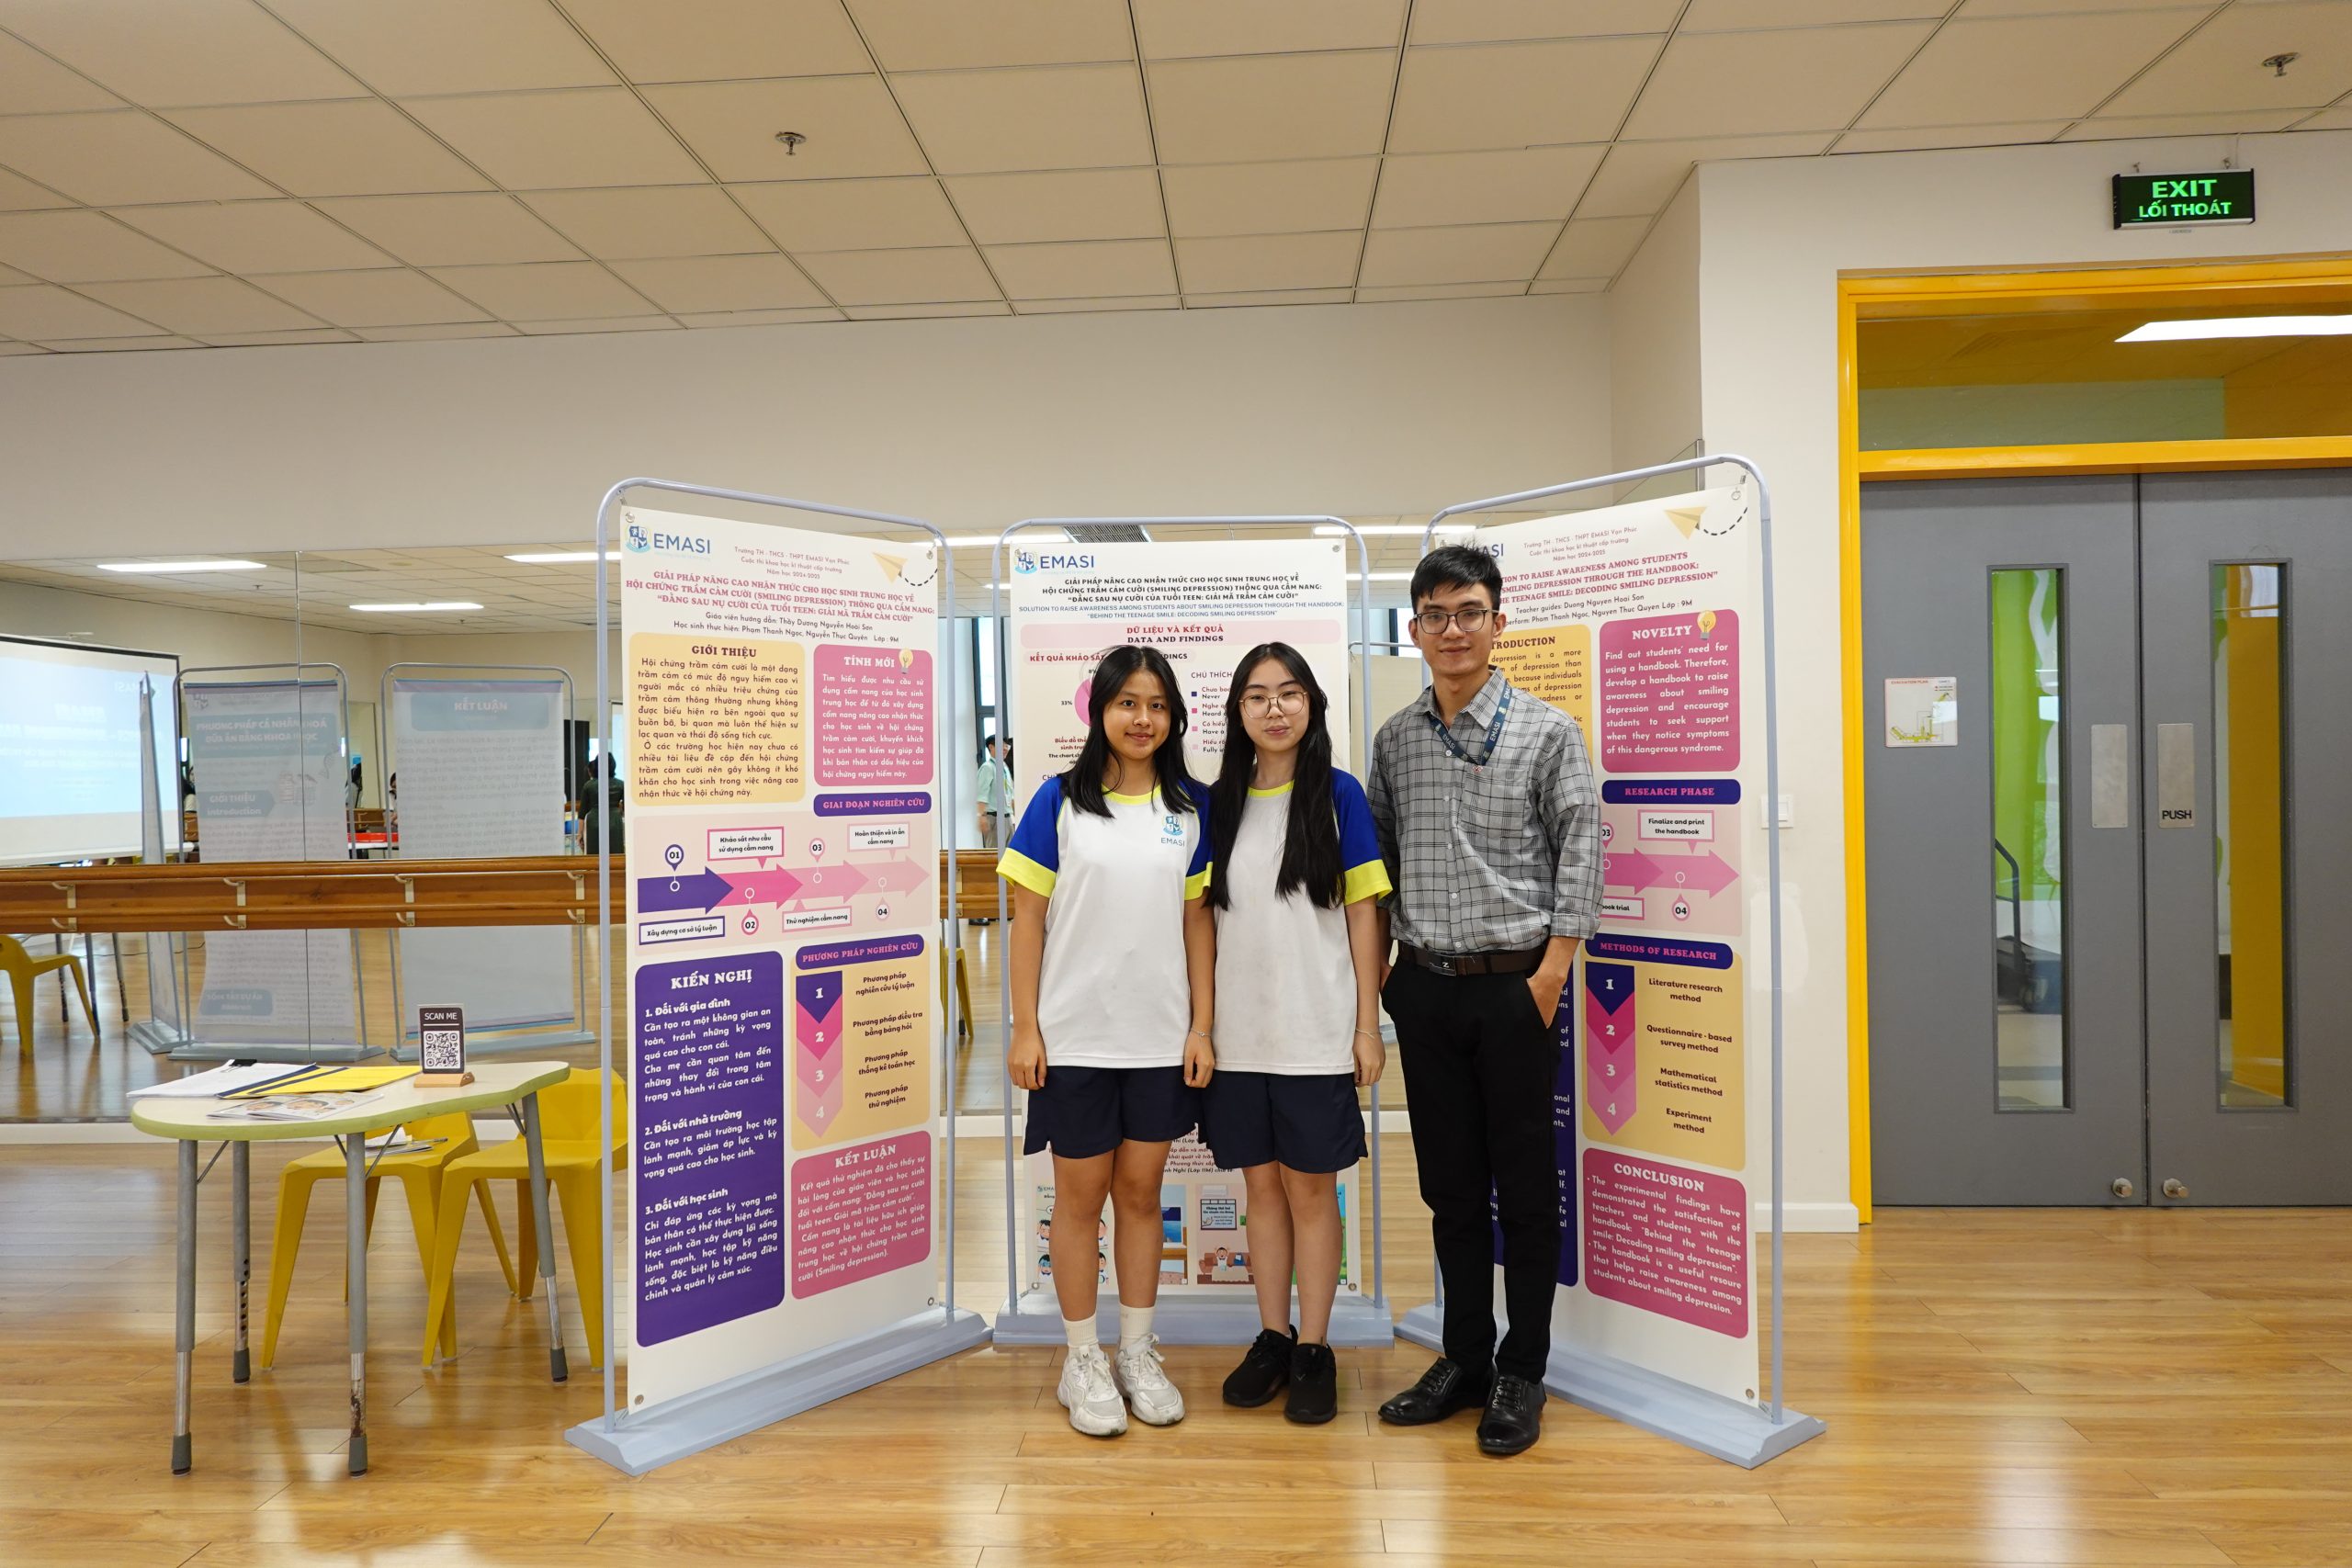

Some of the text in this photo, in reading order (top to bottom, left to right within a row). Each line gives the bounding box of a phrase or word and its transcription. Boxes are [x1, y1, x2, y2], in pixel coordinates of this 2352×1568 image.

[2153, 179, 2217, 198] EXIT
[2139, 199, 2232, 218] LỐI THOÁT
[654, 533, 710, 554] EMASI
[1040, 556, 1094, 569] EMASI
[1532, 570, 1555, 580] RAISE
[1556, 563, 1606, 576] AWARENESS
[1609, 558, 1639, 570] AMONG
[1642, 552, 1688, 565] STUDENTS
[1501, 562, 1699, 593] SMILING DEPRESSION THROUGH THE HANDBOOK:
[1511, 592, 1546, 603] TEENAGE
[1548, 590, 1573, 599] SMILE:
[1576, 583, 1618, 595] DECODING
[1620, 579, 1656, 590] SMILING
[1143, 626, 1163, 635] LIỆU
[1183, 625, 1201, 633] KẾT
[1204, 624, 1224, 634] QUẢ
[1633, 625, 1692, 639] NOVELTY
[1491, 636, 1555, 650] TRODUCTION
[692, 644, 756, 659] GIỚI THIỆU
[1605, 650, 1623, 660] Find
[1628, 650, 1641, 659] out
[1689, 643, 1710, 653] need
[1715, 642, 1728, 651] for
[843, 655, 895, 668] TÍNH MỚI
[1606, 666, 1626, 674] using
[1638, 660, 1681, 671] handbook.
[1684, 657, 1729, 668] Therefore,
[1606, 677, 1637, 687] develop
[1649, 673, 1690, 684] handbook
[1695, 673, 1704, 682] to
[1708, 671, 1729, 681] raise
[1660, 688, 1685, 697] about
[1698, 685, 1729, 696] smiling
[1606, 702, 1729, 716] depression and encourage
[1606, 718, 1640, 728] students
[1668, 716, 1686, 725] seek
[1696, 715, 1729, 726] support
[1489, 721, 1501, 742] EMASI
[1607, 732, 1627, 740] when
[1633, 731, 1650, 741] they
[1687, 729, 1730, 739] symptoms
[1442, 734, 1455, 750] EMASI
[1607, 742, 1724, 755] of this dangerous syndrome.
[1681, 787, 1714, 795] PHASE
[823, 797, 924, 809] GIAI ĐOẠN NGHIÊN CỨU
[2162, 810, 2192, 819] PUSH
[1161, 838, 1185, 847] EMASI
[669, 851, 683, 862] 01
[1675, 907, 1687, 915] 04
[745, 921, 757, 931] 02
[803, 942, 918, 963] PHƯƠNG PHÁP NGHIÊN CỨU
[1601, 942, 1645, 953] METHODS
[1663, 948, 1716, 960] RESEARCH
[671, 969, 752, 989] KIẾN NGHỊ
[1606, 979, 1614, 990] 1
[1649, 978, 1723, 993] Literature research
[816, 987, 823, 998] 1
[1670, 994, 1702, 1002] method
[646, 998, 730, 1018] 1. Đối với gia đình
[424, 1012, 445, 1021] SCAN
[1606, 1025, 1615, 1036] 2
[1646, 1024, 1732, 1043] Questionnaire based
[816, 1032, 824, 1043] 2
[1660, 1040, 1718, 1053] survey method
[816, 1070, 824, 1082] 3
[1607, 1065, 1615, 1077] 3
[1660, 1067, 1717, 1083] Mathematical
[1655, 1079, 1723, 1097] statistics method
[816, 1106, 824, 1118] 4
[1608, 1103, 1616, 1115] 4
[1666, 1108, 1712, 1122] Experiment
[1674, 1122, 1704, 1134] method
[835, 1145, 896, 1168] KẾT LUẬN
[1614, 1164, 1704, 1192] CONCLUSION
